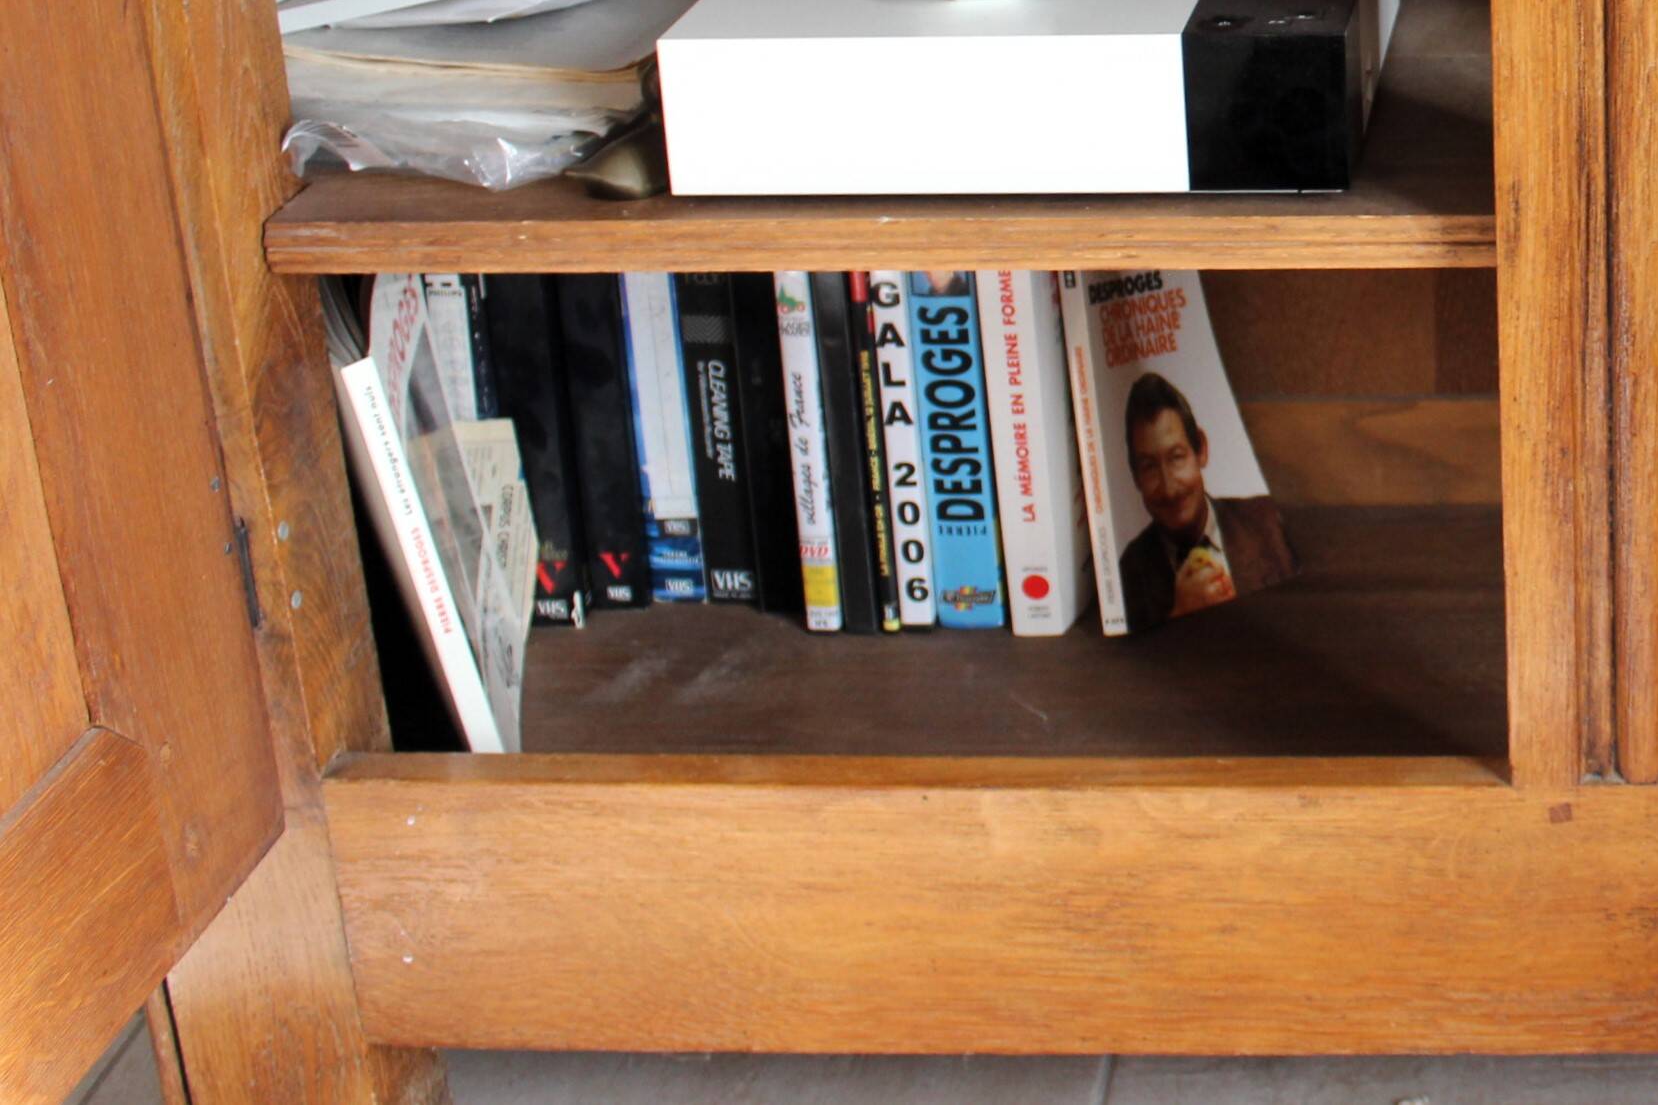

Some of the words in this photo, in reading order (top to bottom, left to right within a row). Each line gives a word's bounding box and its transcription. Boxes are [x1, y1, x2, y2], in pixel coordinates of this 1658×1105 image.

[1002, 269, 1016, 326] FORME
[1088, 273, 1163, 305] DESPROGES
[1135, 311, 1181, 336] HAINE
[870, 281, 914, 426] GALA
[1007, 334, 1021, 386] PLEINE
[707, 360, 730, 439] CLEANING
[786, 372, 810, 428] France
[917, 302, 985, 522] DESPROGES
[1009, 393, 1025, 415] EN
[371, 411, 388, 438] sont
[716, 443, 735, 481] TAPE
[793, 436, 809, 457] de
[1013, 423, 1032, 497] MÉMOIRE
[798, 465, 819, 524] villages
[664, 520, 690, 534] VHS
[1020, 503, 1036, 523] LA
[893, 464, 930, 602] 2006
[411, 527, 438, 592] DESPROGES
[606, 586, 632, 601] VHS
[666, 579, 695, 592] VHS
[711, 570, 753, 591] VHS
[536, 598, 568, 616] VHS
